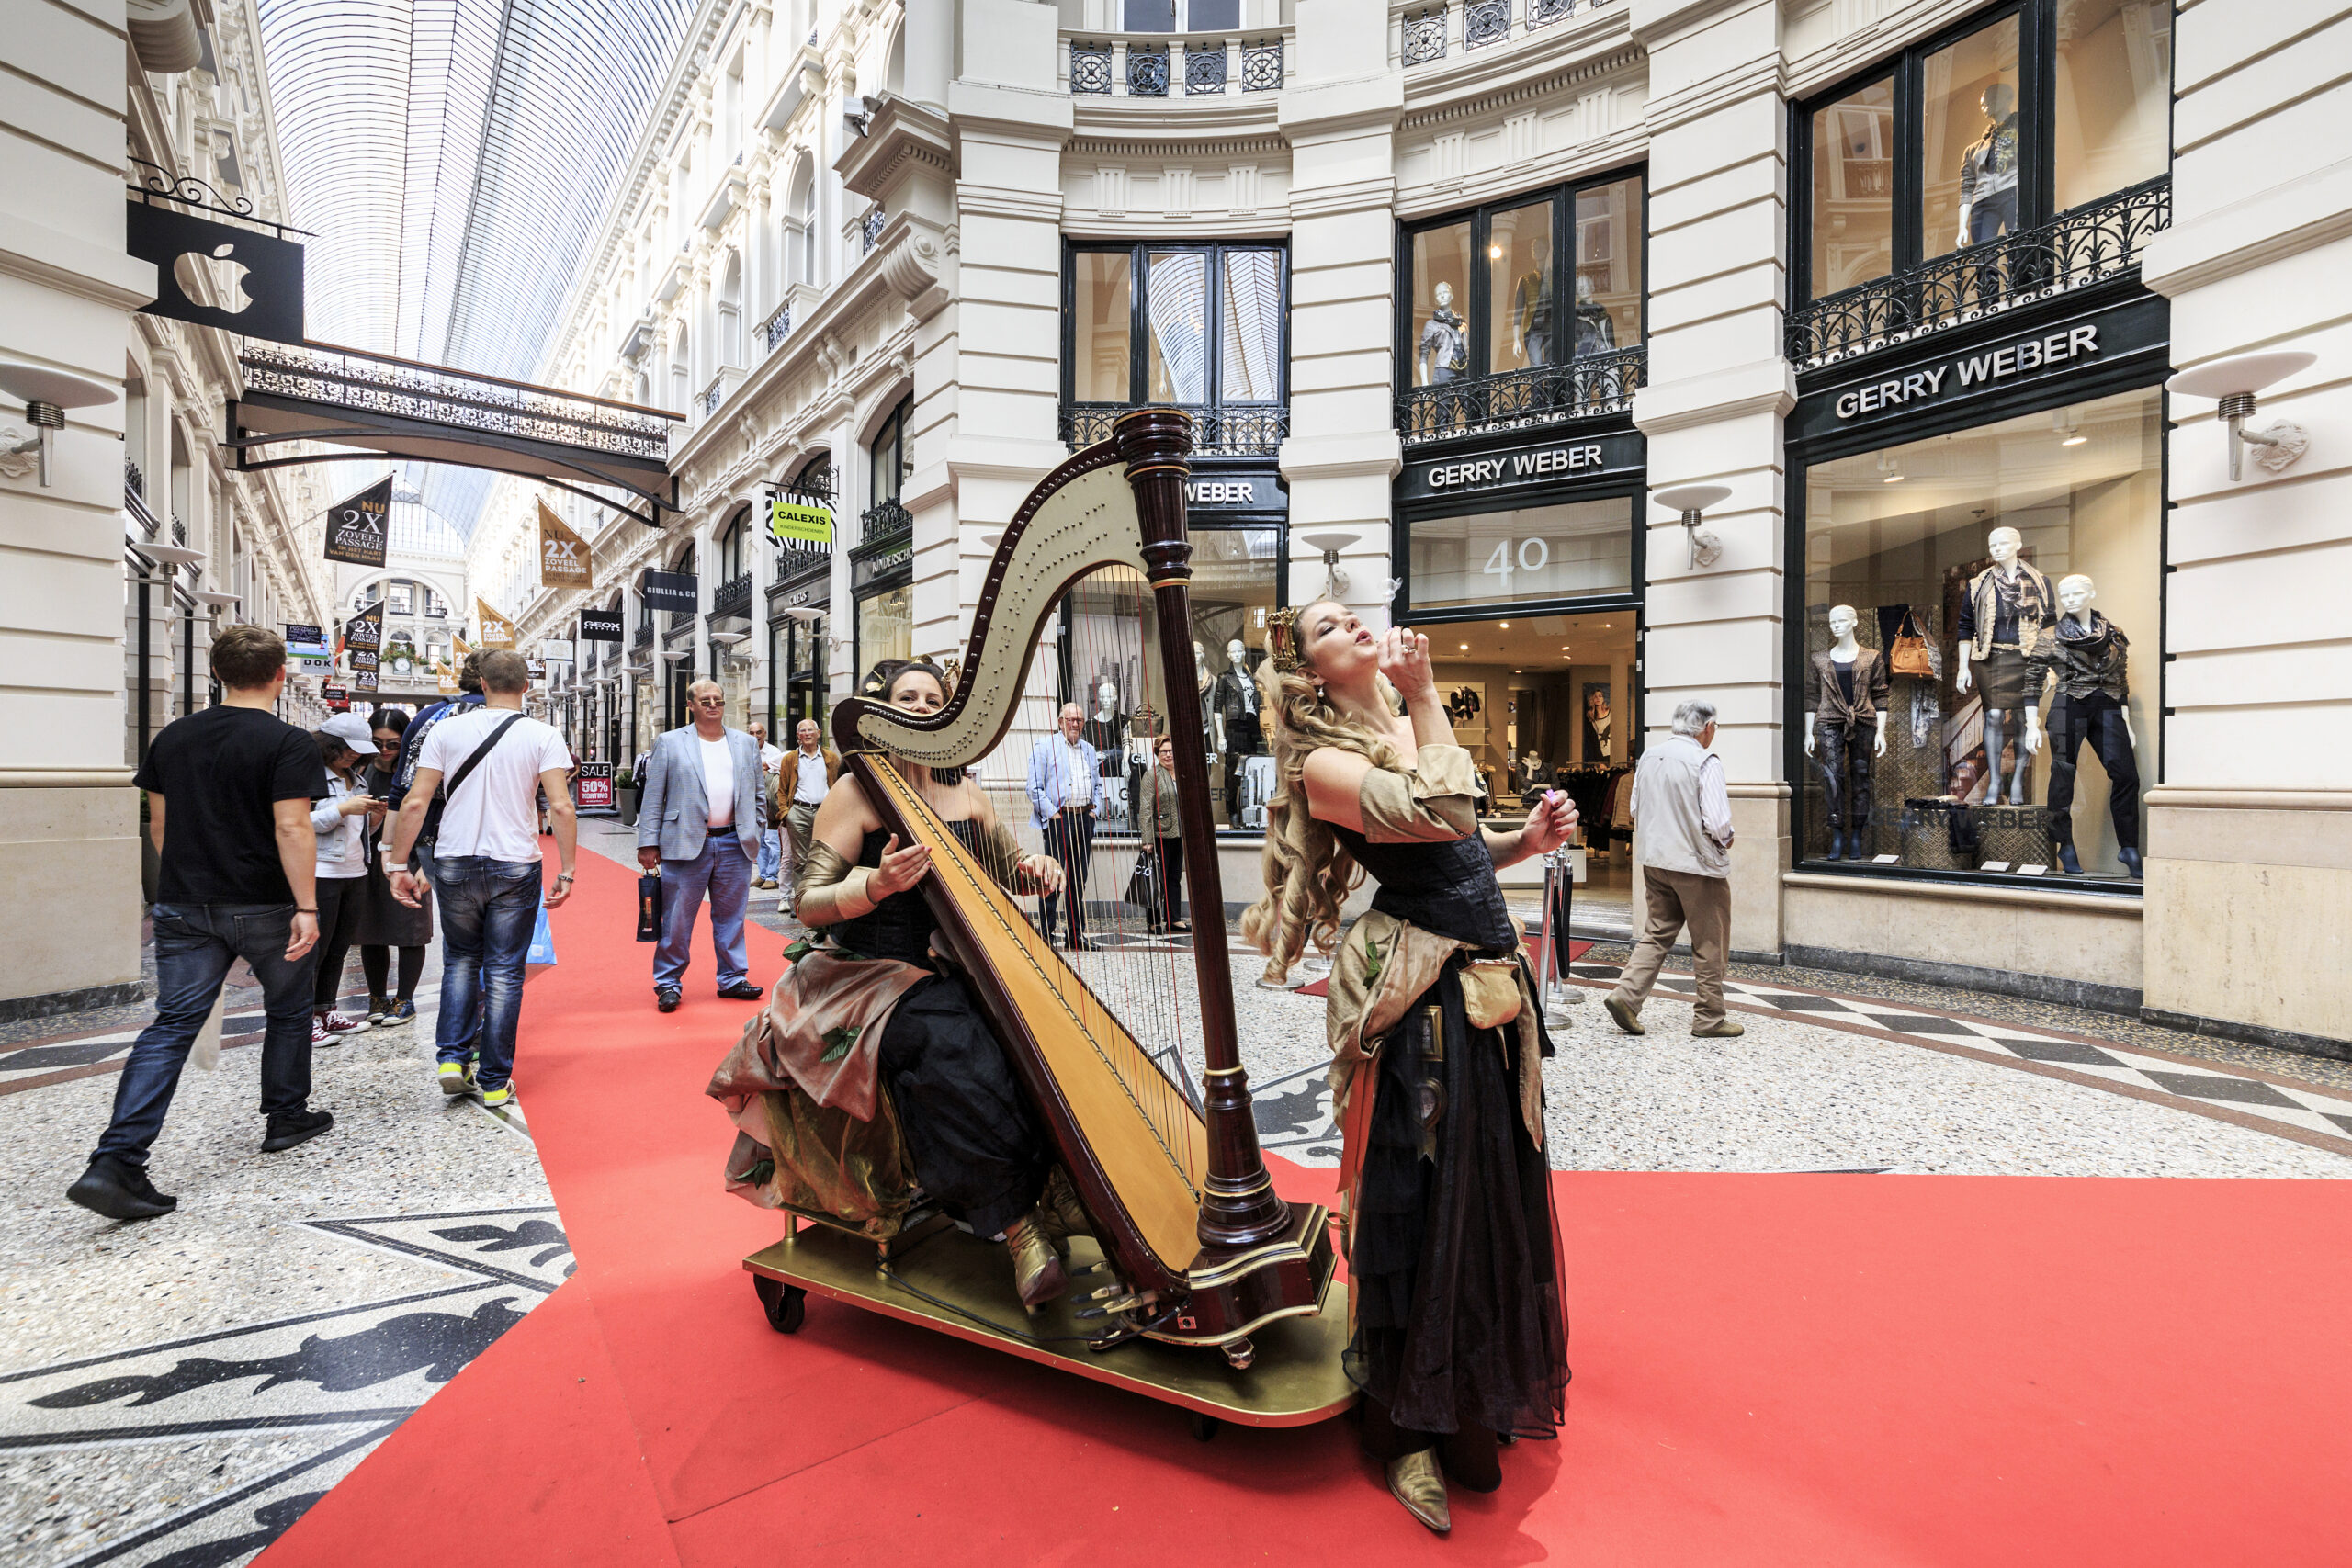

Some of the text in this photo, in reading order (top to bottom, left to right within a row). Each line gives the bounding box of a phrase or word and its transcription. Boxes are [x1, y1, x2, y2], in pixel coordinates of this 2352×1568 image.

[1836, 324, 2099, 419] GERRY WEBER
[1428, 444, 1603, 488] GERRY WEBER
[1184, 482, 1253, 502] WEBER
[361, 500, 385, 514] NU
[341, 509, 383, 536] 2X
[778, 511, 826, 525] CALEXIS
[337, 528, 383, 544] ZOVEEL
[544, 529, 564, 540] NU
[779, 525, 824, 534] KINDERSCHOENEN
[334, 536, 383, 551] PASSAGE
[544, 539, 578, 559] 2X
[544, 558, 579, 567] ZOVEEL
[1483, 537, 1549, 588] 40
[545, 565, 587, 574] PASSAGE
[647, 586, 677, 596] GIULLIA
[366, 615, 379, 623] NU
[584, 620, 620, 629] GEOX
[355, 620, 379, 635] 2X
[482, 620, 505, 633] 2X
[304, 659, 331, 667] DOK
[362, 671, 378, 681] 2X
[582, 765, 609, 777] SALE
[582, 780, 608, 793] 50%
